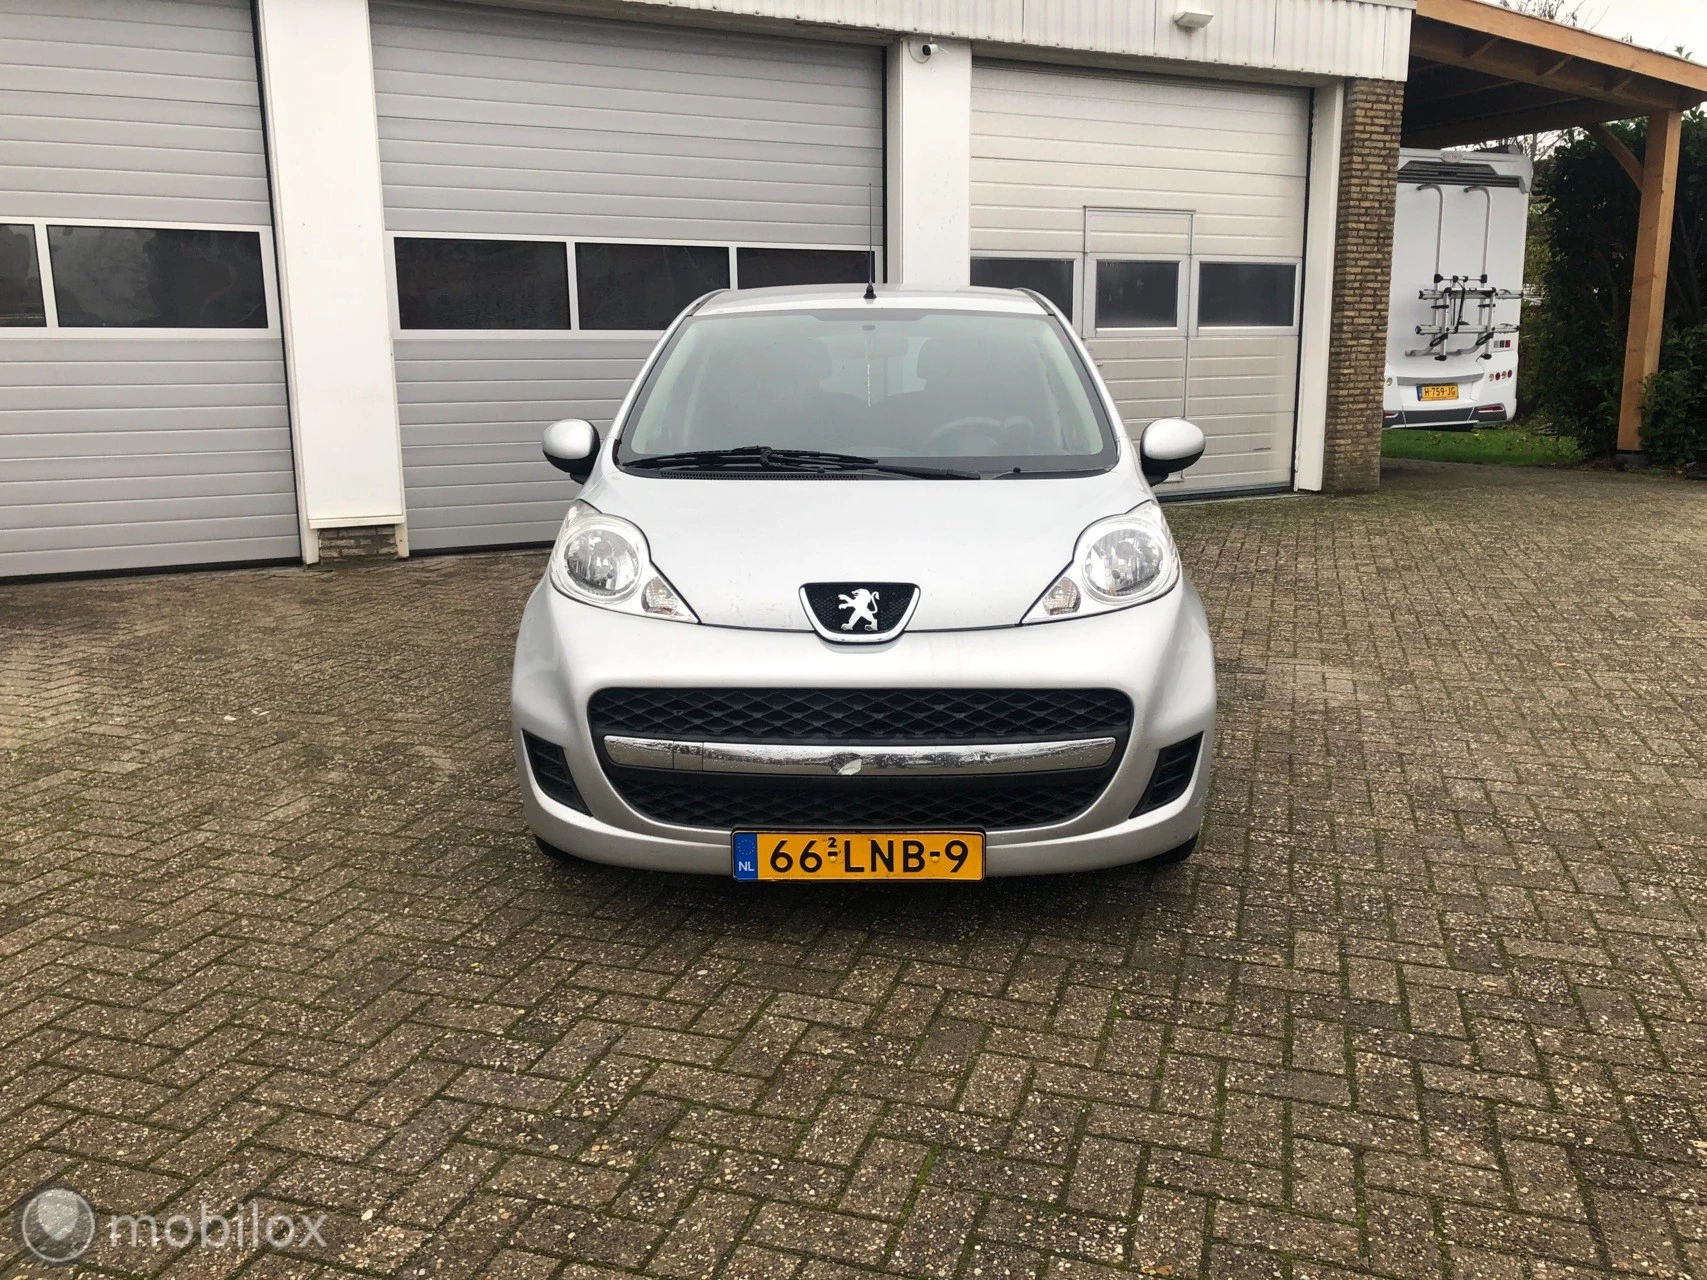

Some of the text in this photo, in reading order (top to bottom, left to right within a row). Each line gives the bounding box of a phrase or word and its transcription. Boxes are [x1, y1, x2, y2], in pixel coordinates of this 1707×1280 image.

[1424, 386, 1456, 397] H-759-JG
[770, 839, 969, 873] 66-LNB-9
[738, 861, 755, 872] NL
